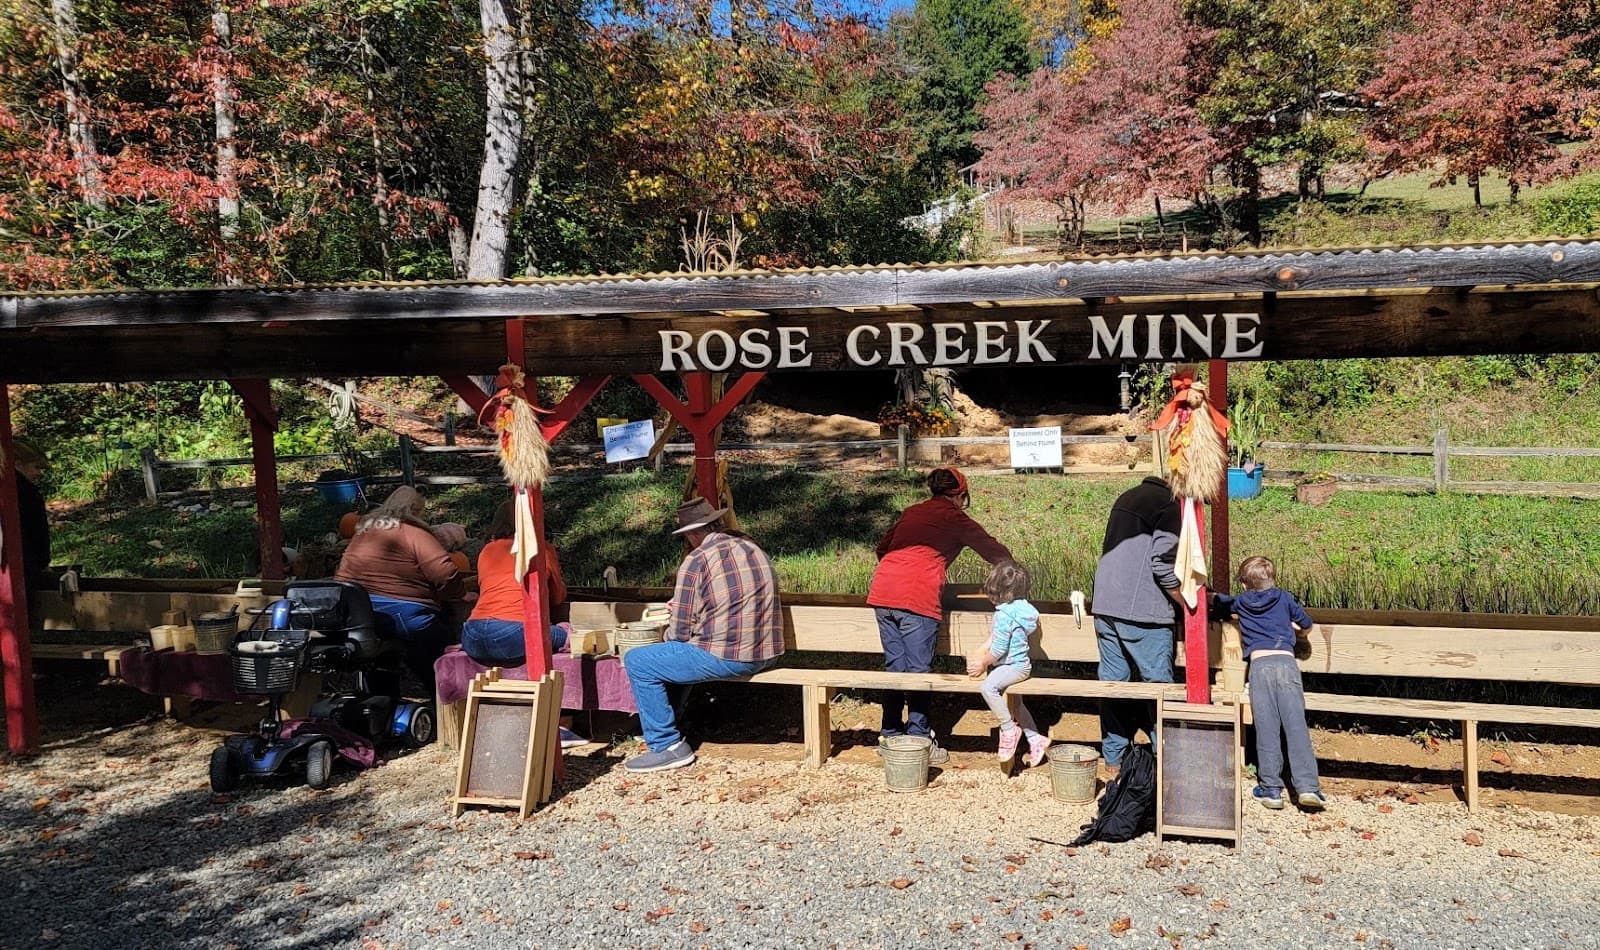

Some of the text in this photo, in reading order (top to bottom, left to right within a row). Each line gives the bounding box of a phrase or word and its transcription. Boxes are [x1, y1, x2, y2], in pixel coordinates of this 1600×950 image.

[658, 313, 1264, 371] ROSE CREEK MINE
